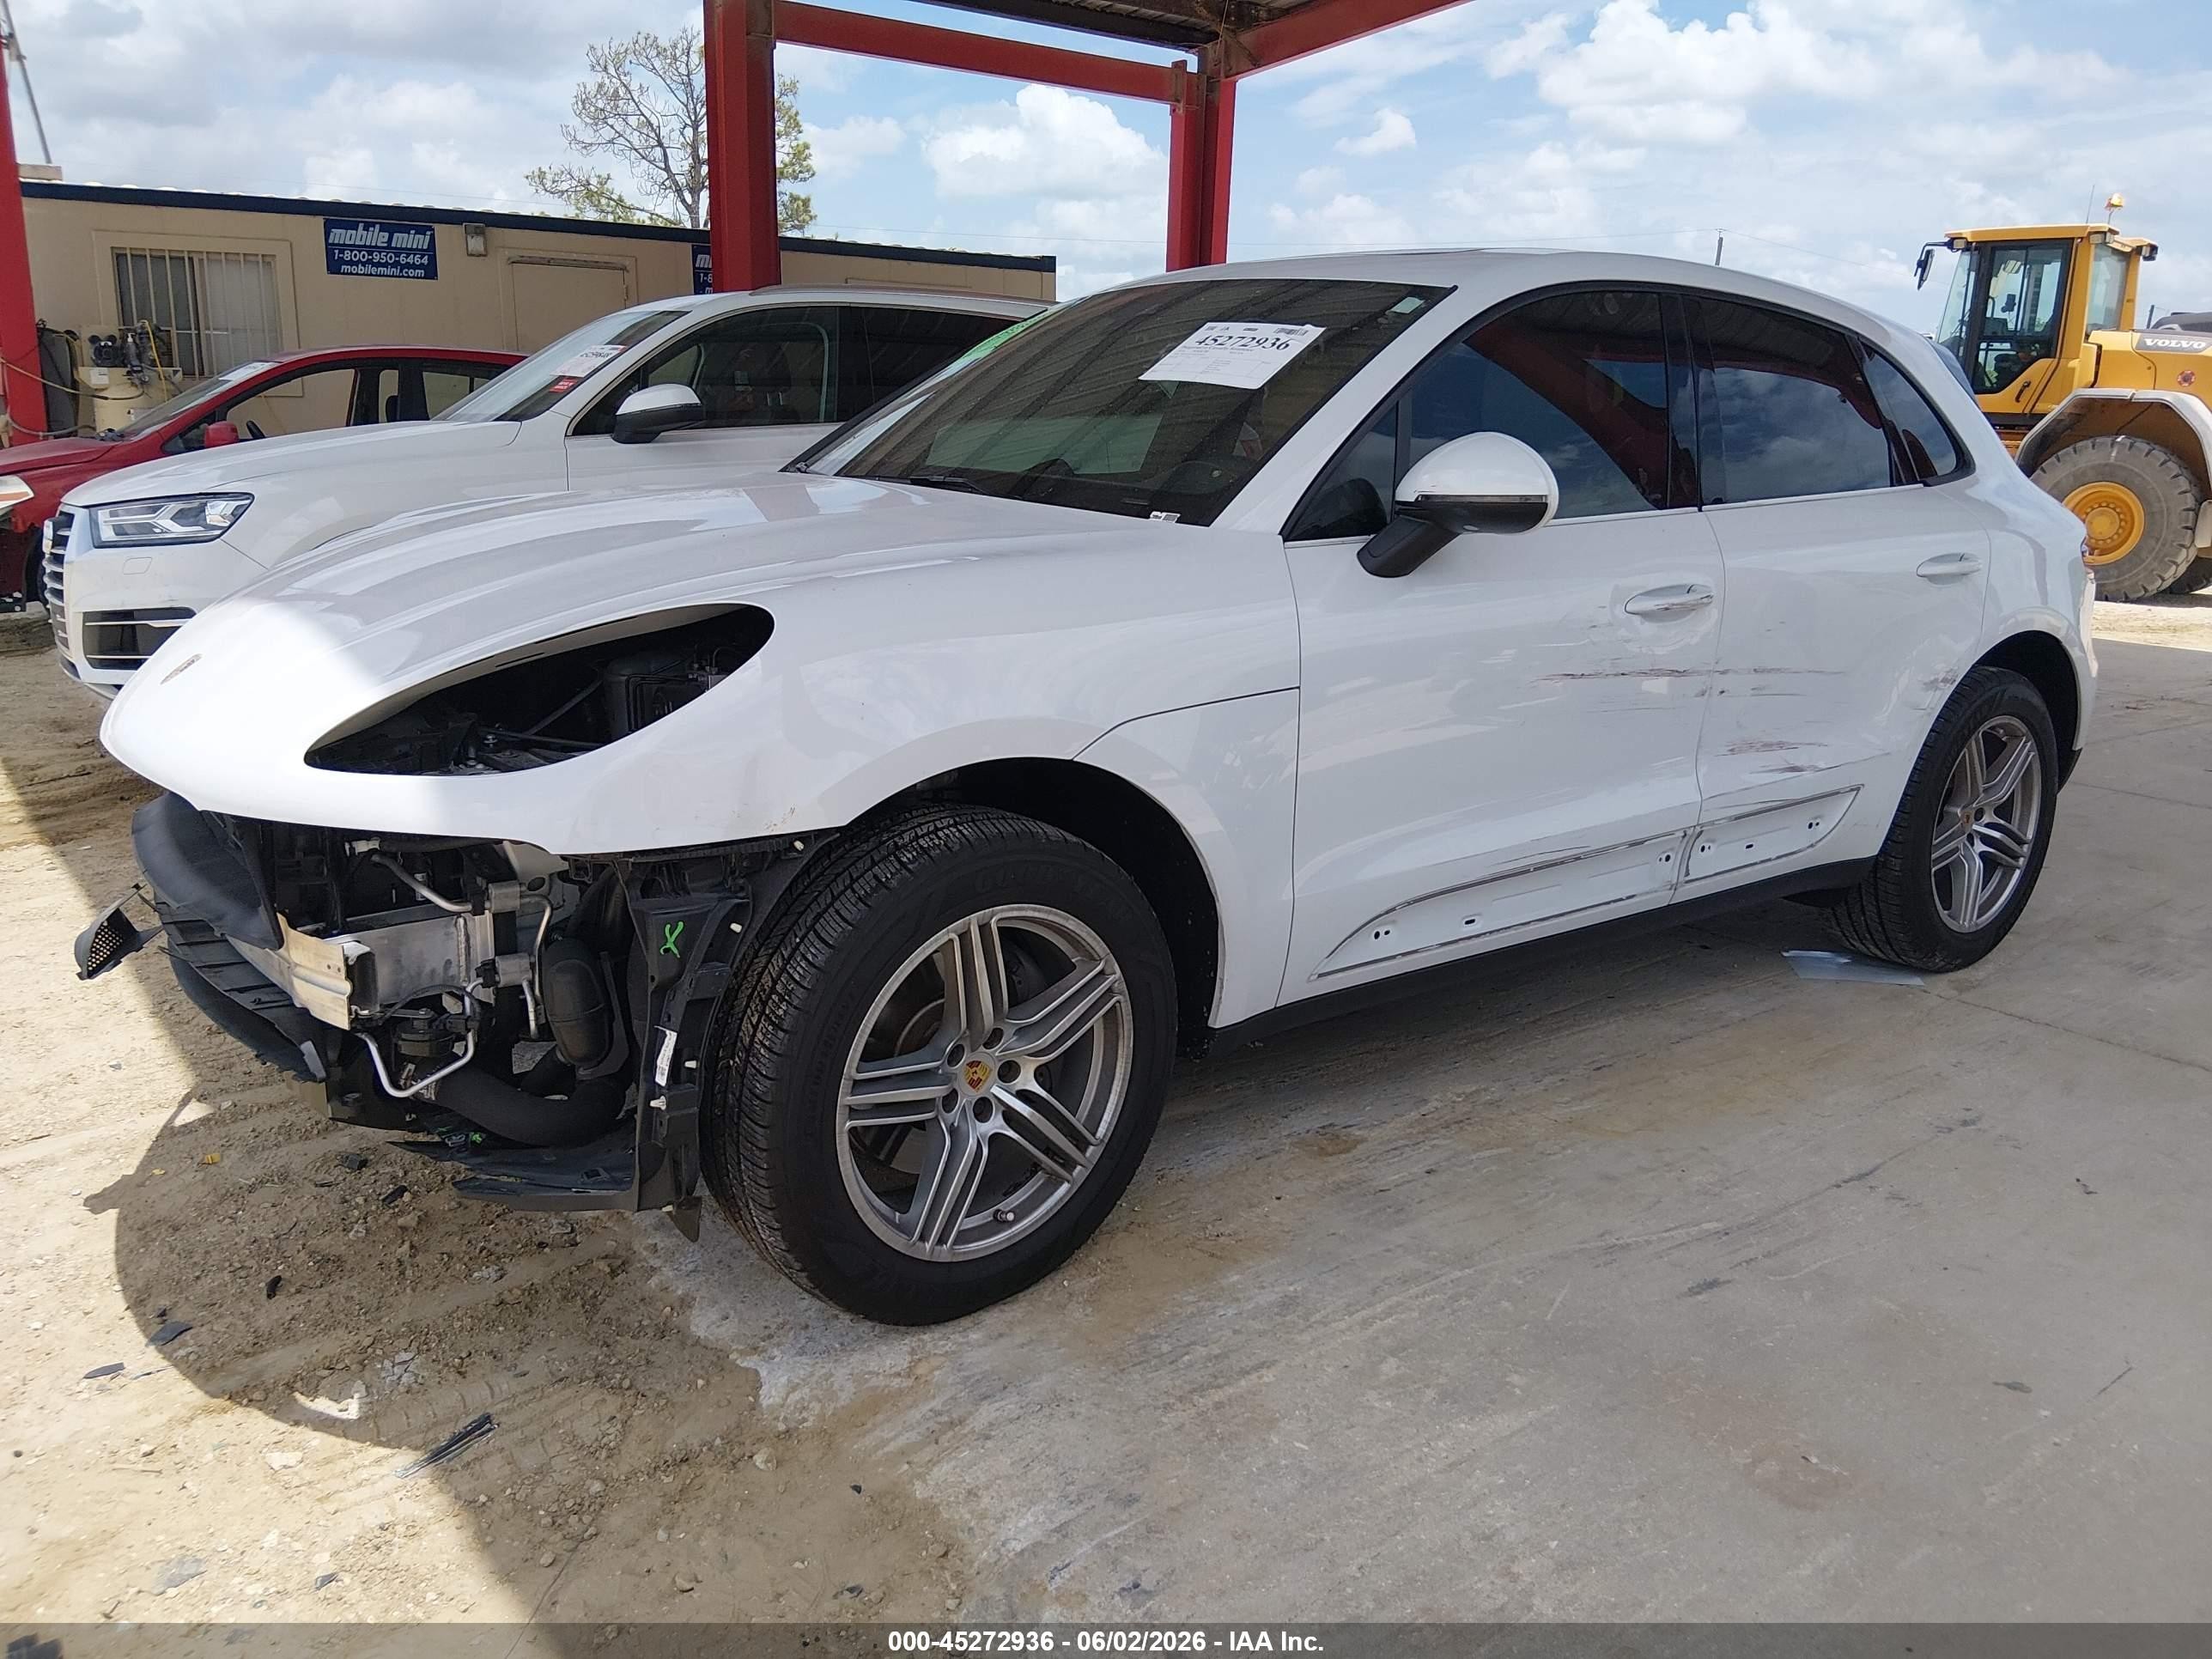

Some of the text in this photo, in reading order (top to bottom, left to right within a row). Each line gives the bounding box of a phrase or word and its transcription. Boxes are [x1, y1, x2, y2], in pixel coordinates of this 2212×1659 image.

[328, 223, 431, 249] mobile mini
[333, 249, 429, 266] 1-800-950-6464
[340, 263, 425, 277] mobilemini.com
[1195, 335, 1291, 351] 45272936
[2143, 338, 2206, 349] VOLVO
